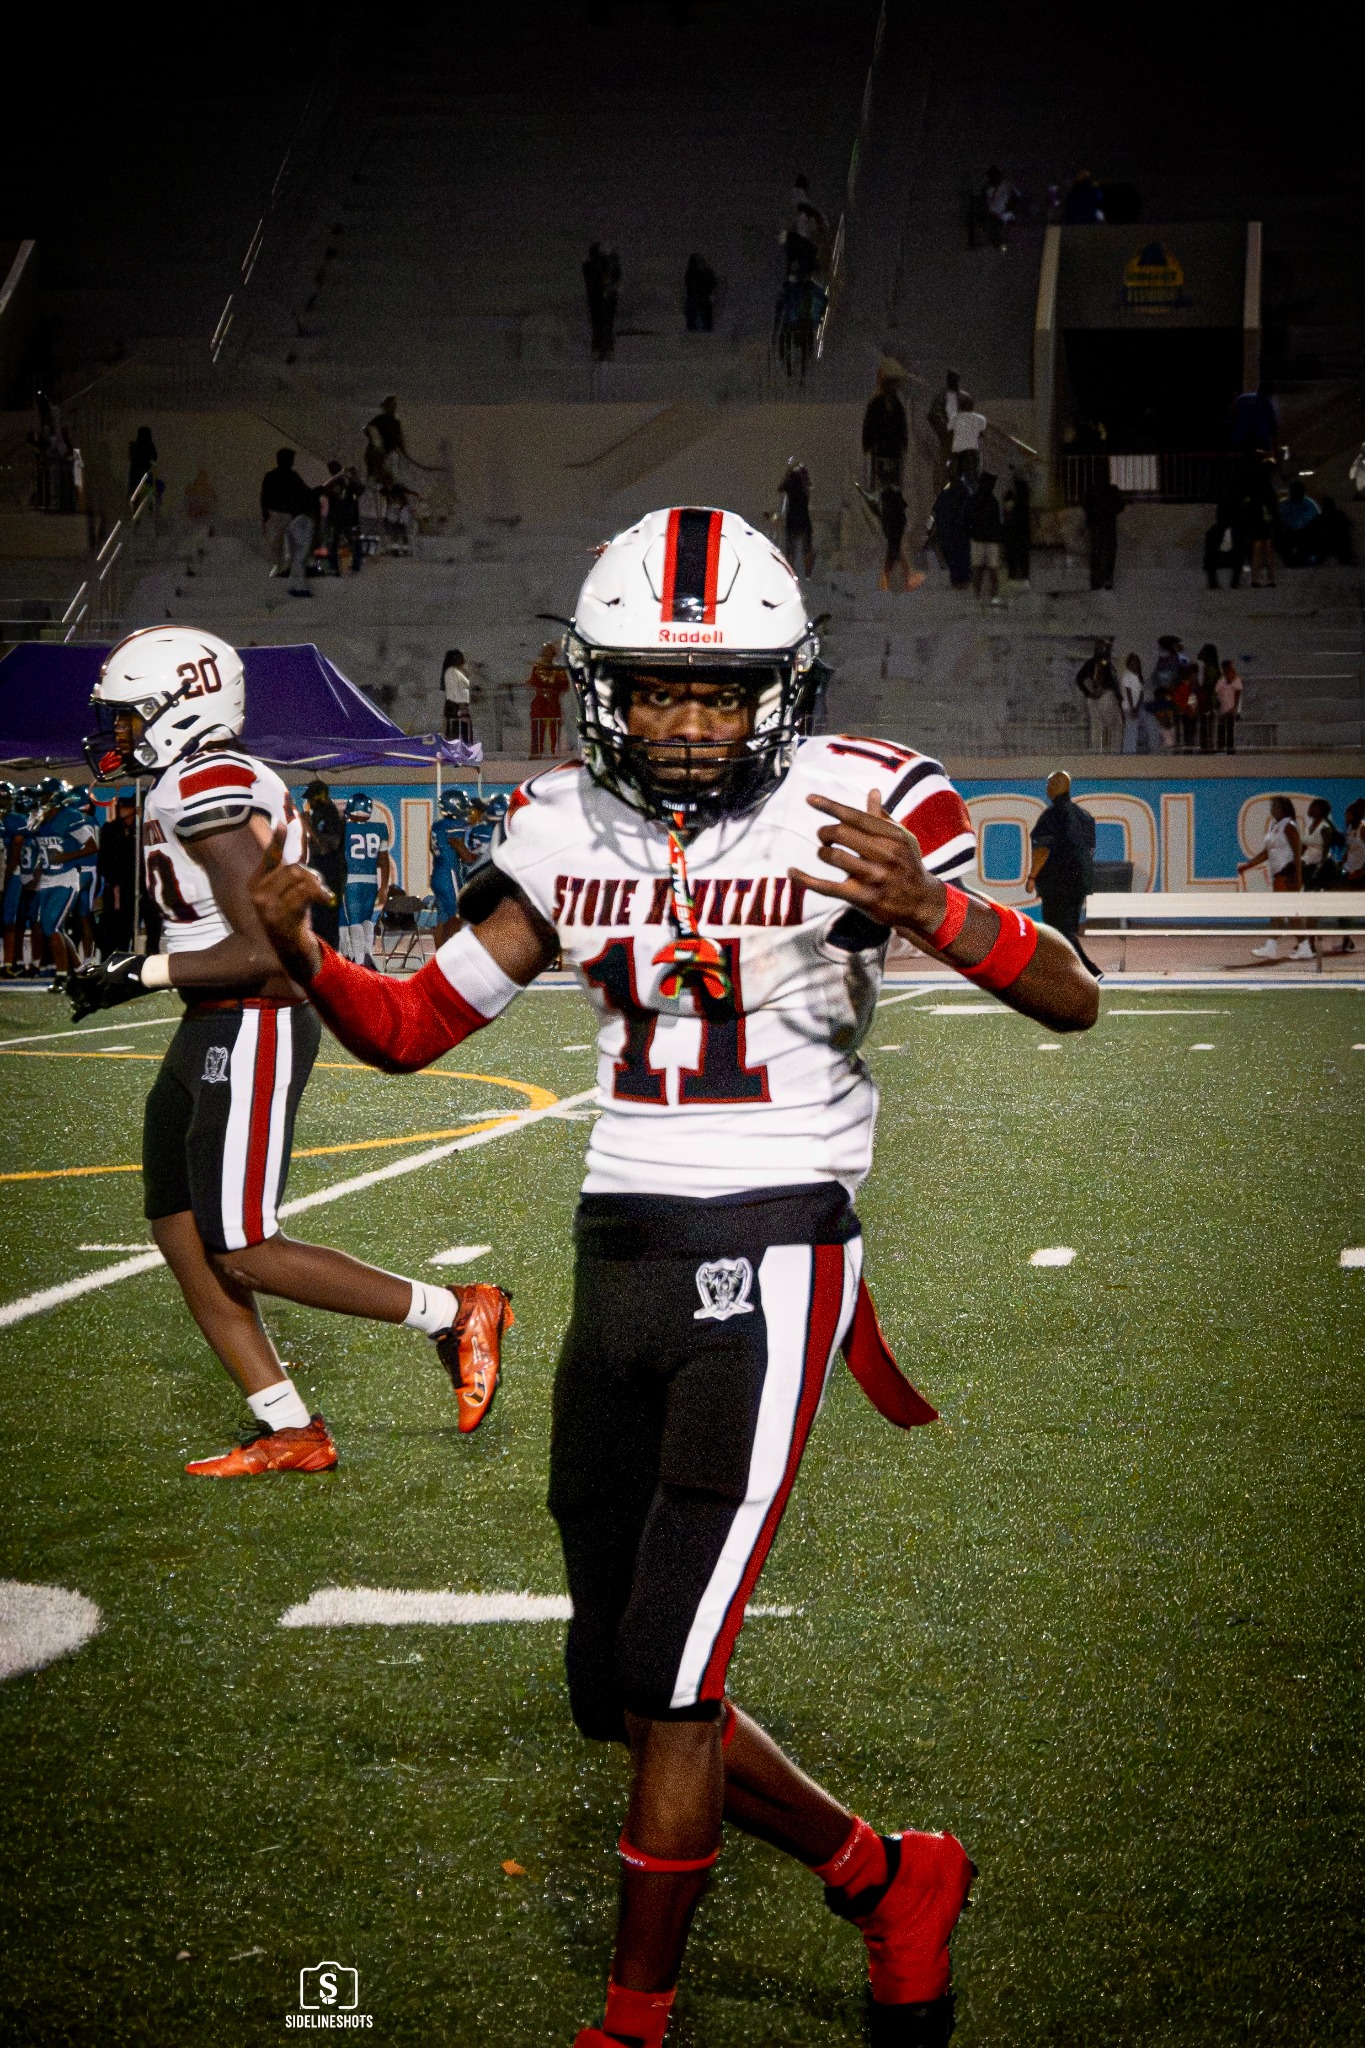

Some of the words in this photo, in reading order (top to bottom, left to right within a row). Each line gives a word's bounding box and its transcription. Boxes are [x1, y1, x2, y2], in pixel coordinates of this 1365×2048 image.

[658, 629, 723, 643] Riddell
[176, 658, 222, 700] 20
[350, 833, 381, 860] 28
[583, 937, 772, 1104] 11
